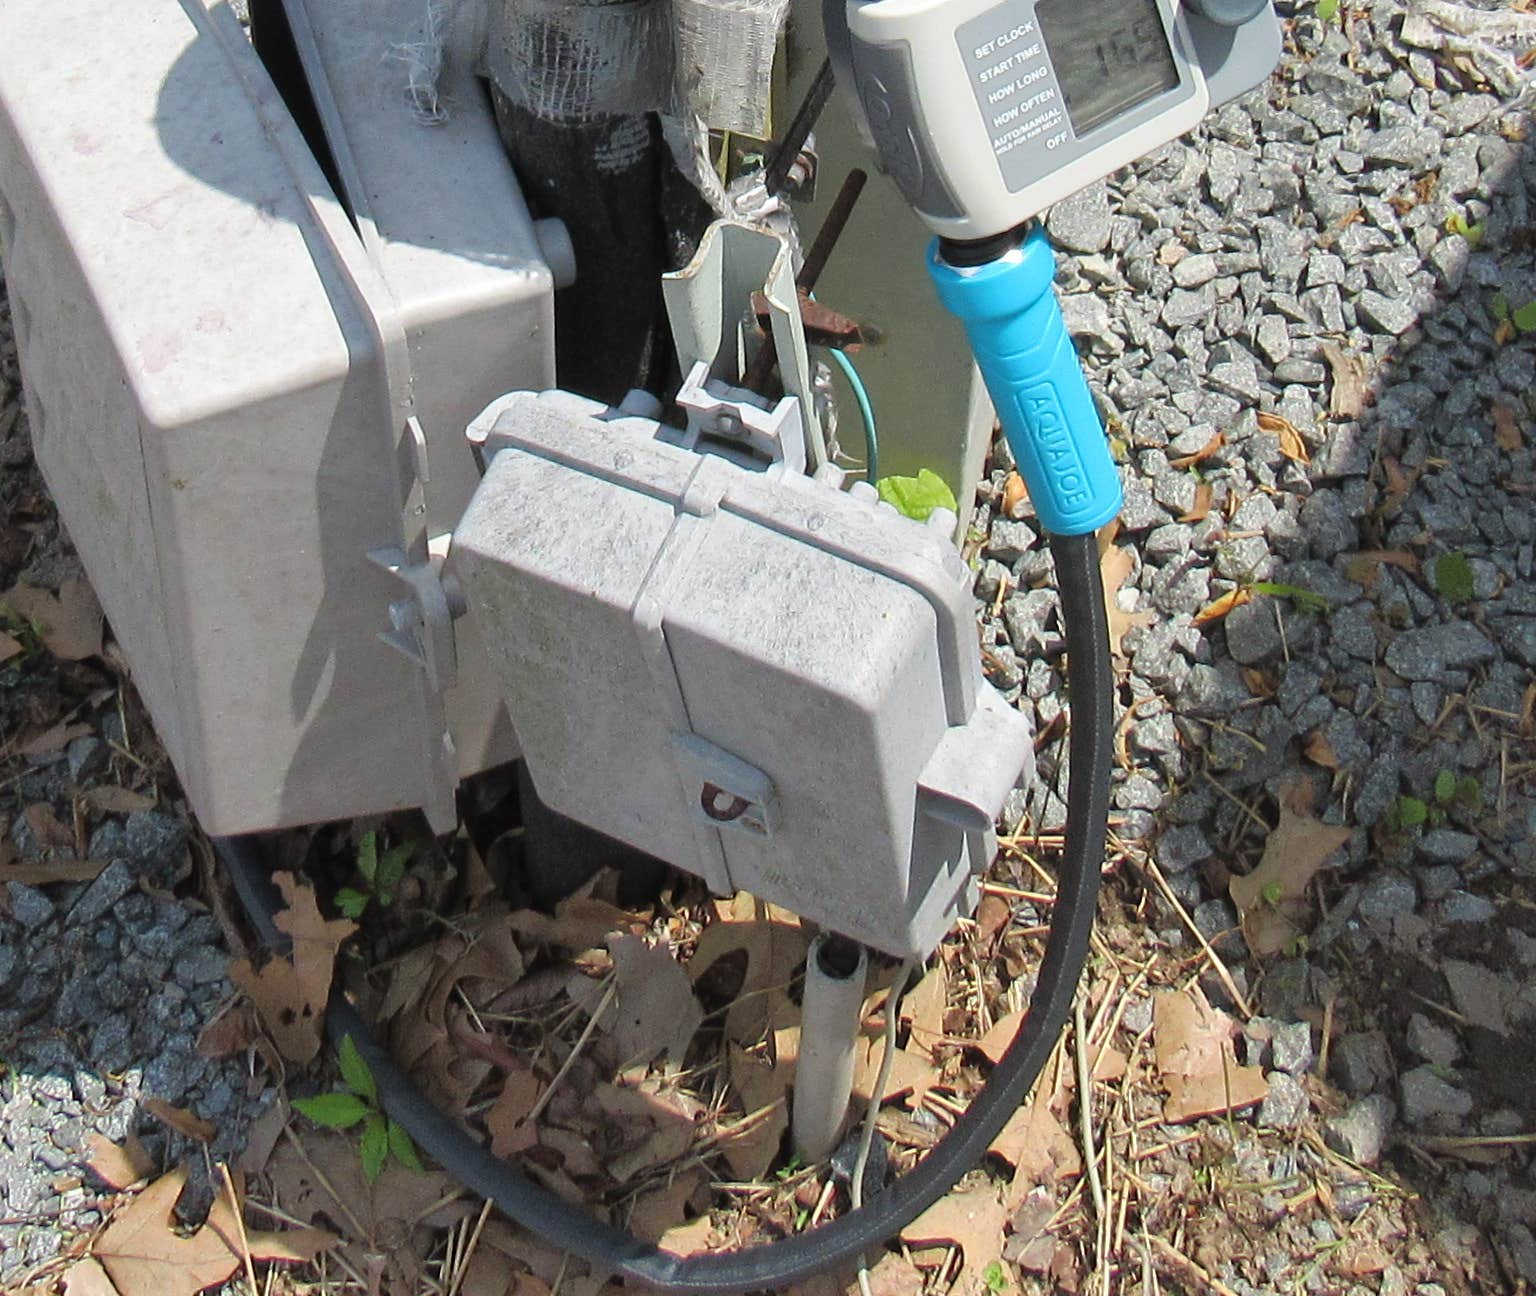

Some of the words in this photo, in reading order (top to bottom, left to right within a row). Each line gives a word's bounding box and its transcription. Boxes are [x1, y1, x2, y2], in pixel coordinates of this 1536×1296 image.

[975, 39, 995, 59] SET
[997, 21, 1034, 47] CLOCK
[980, 57, 1017, 83] START
[1015, 43, 1041, 64] TIME
[988, 83, 1015, 104] HOW
[1016, 66, 1048, 89] LONG
[993, 106, 1019, 127] HOW
[1020, 87, 1055, 112] OFTEN
[1042, 115, 1064, 131] DELAY
[1046, 131, 1068, 150] OFF
